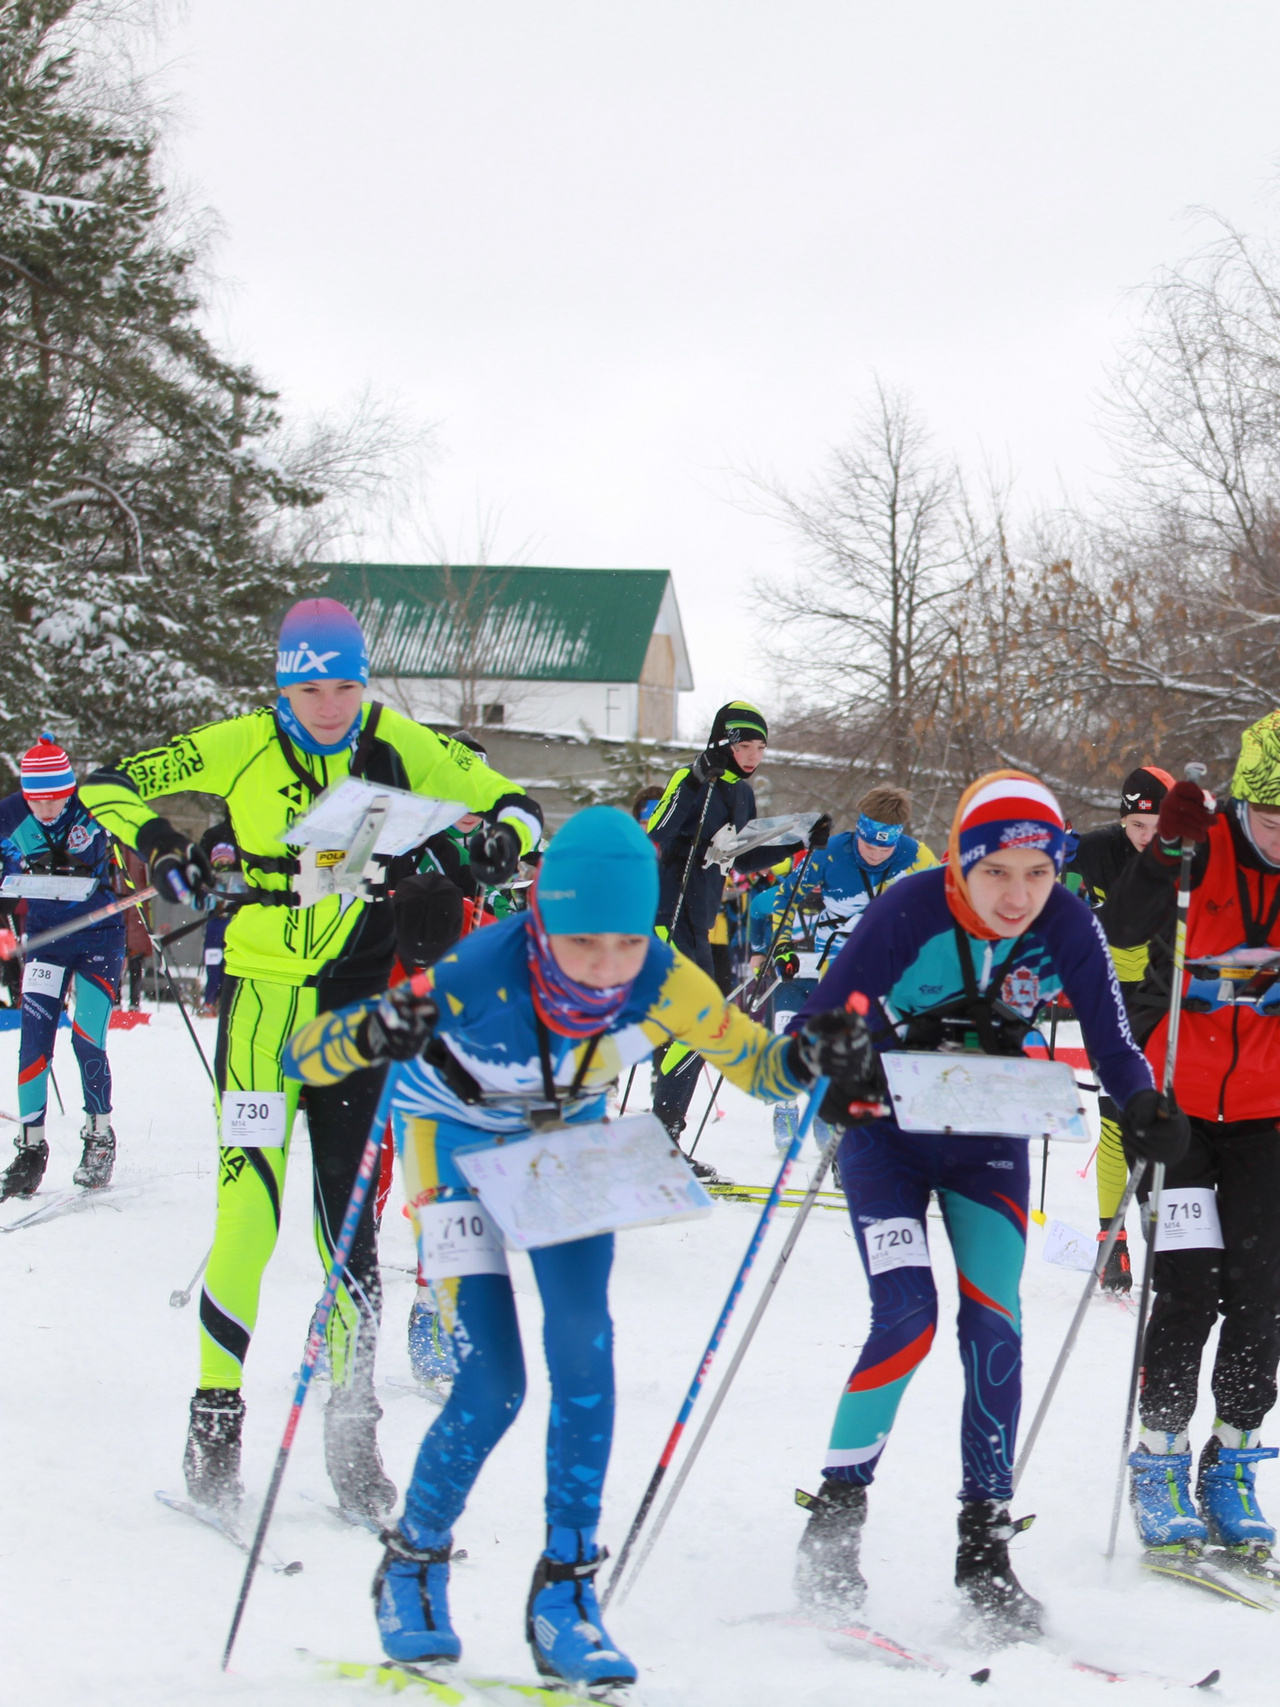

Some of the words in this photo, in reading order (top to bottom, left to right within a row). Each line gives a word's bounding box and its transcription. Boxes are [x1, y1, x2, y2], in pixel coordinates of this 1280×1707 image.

[31, 968, 52, 980] 738
[780, 1015, 790, 1023] 77
[236, 1103, 269, 1120] 730
[1168, 1203, 1202, 1220] 719
[438, 1216, 484, 1239] 710
[873, 1228, 914, 1251] 720
